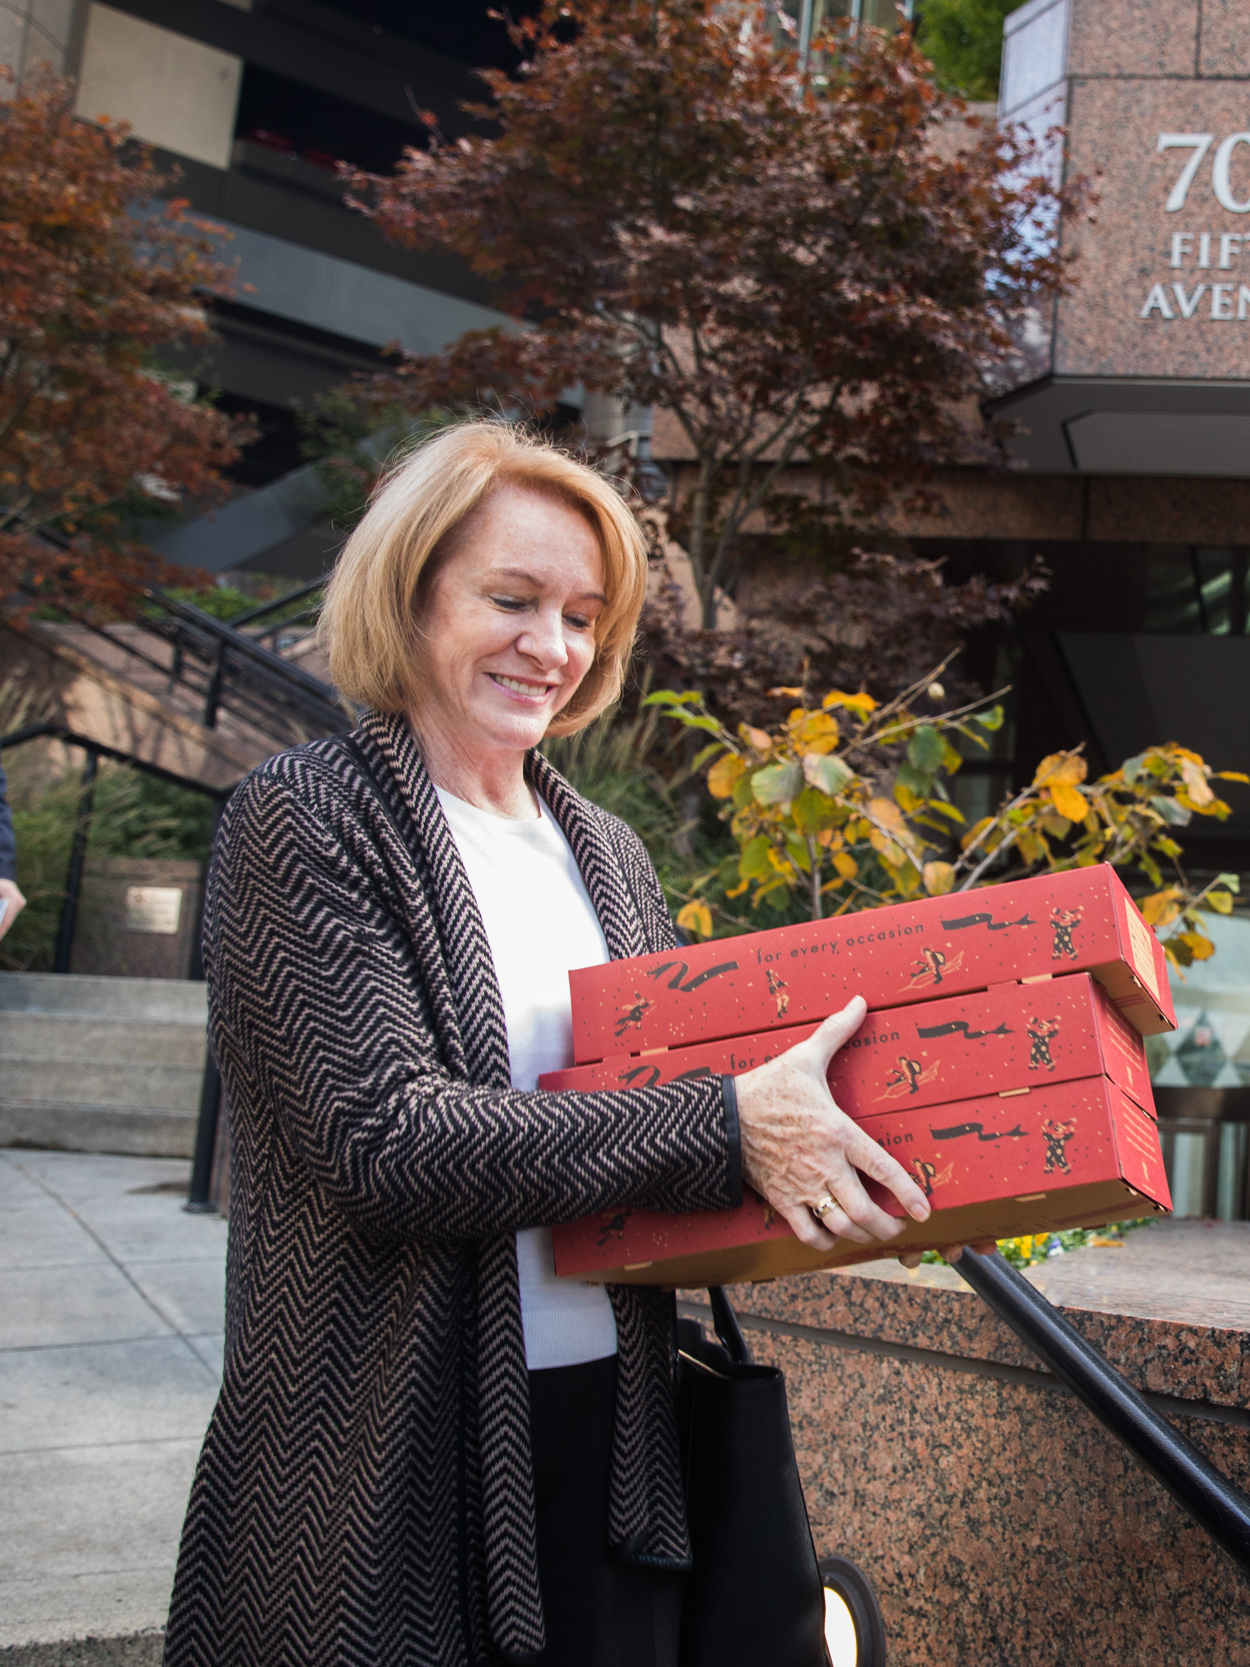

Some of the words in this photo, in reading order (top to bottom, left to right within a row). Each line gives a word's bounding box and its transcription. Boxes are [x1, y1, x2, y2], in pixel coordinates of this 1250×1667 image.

[757, 948, 782, 964] for
[846, 924, 924, 946] occasion
[730, 1054, 755, 1070] for
[842, 1031, 900, 1050] casion
[878, 1132, 913, 1147] sion
